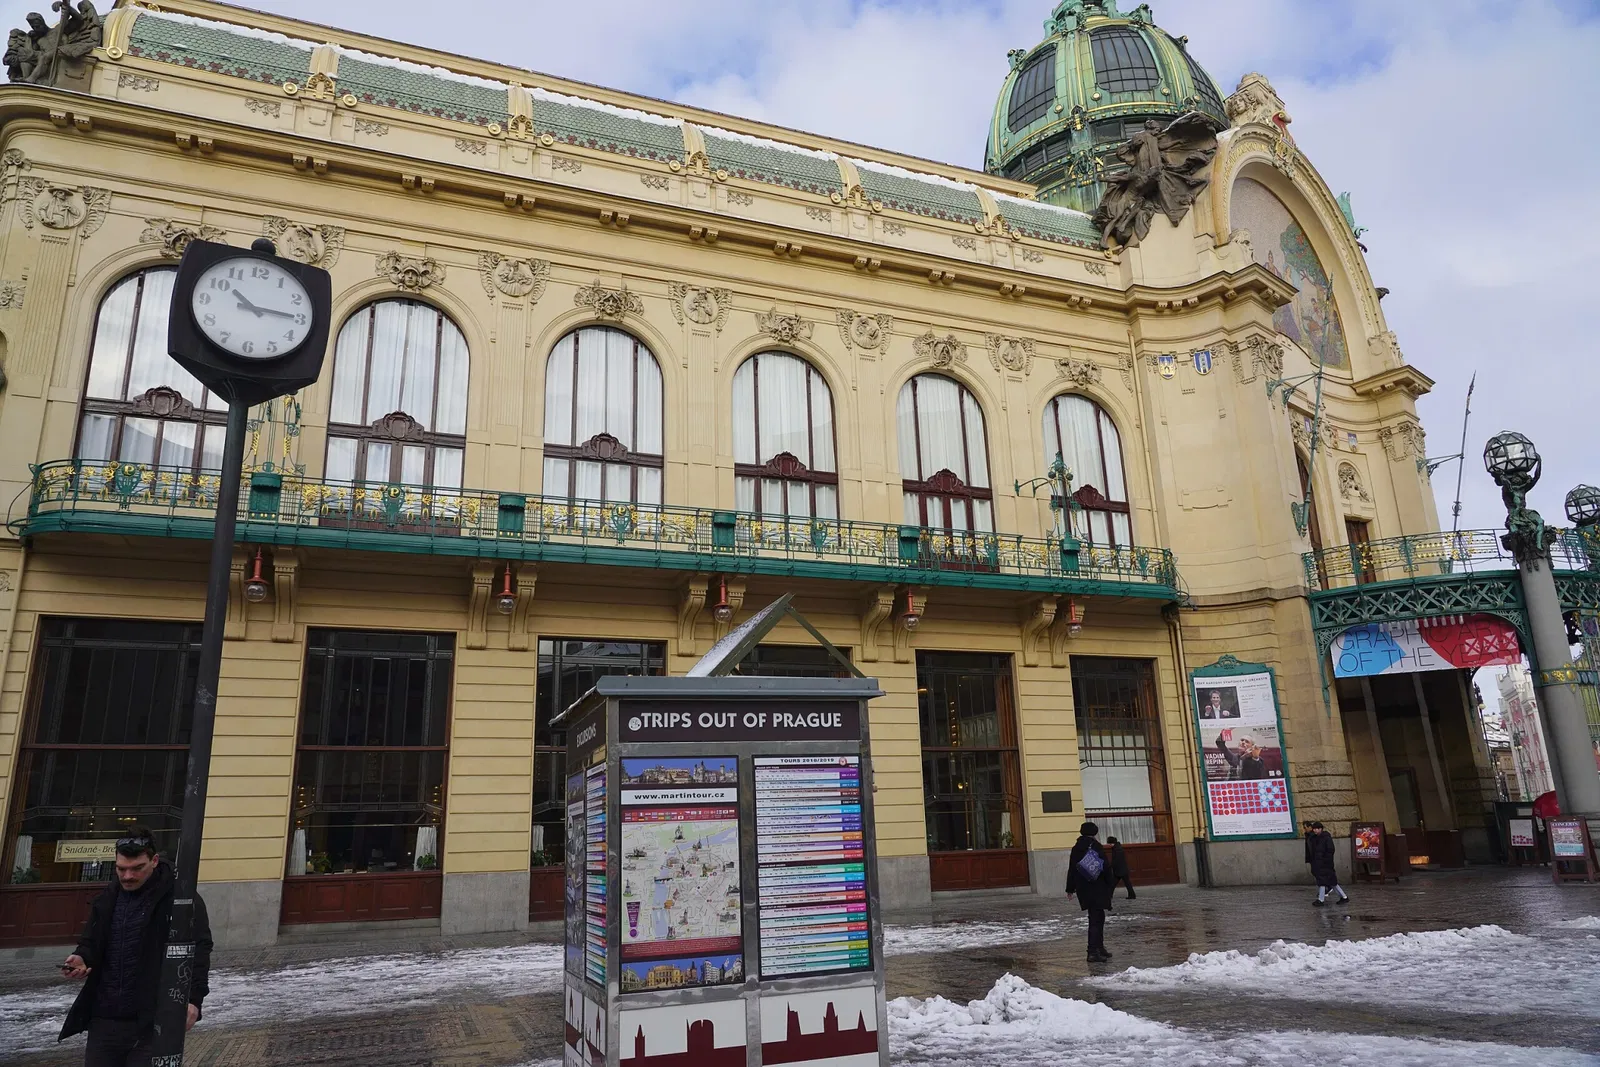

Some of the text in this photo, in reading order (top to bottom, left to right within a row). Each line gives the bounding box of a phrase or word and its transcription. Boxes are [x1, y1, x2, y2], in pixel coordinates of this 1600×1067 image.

[228, 266, 244, 281] 11
[250, 266, 270, 280] 12
[209, 277, 231, 291] 10
[276, 277, 285, 289] 1
[199, 292, 211, 305] 9
[290, 293, 303, 305] 2
[203, 313, 216, 327] 8
[295, 313, 307, 326] 3
[219, 331, 232, 344] 7
[283, 329, 295, 342] 4
[242, 340, 254, 354] 6
[267, 340, 278, 353] 5
[1335, 620, 1449, 651] GRAPHIC
[1339, 651, 1372, 672] OF
[1381, 646, 1434, 668] THE
[641, 712, 842, 728] TRIPS OUT OF PRAGUE
[634, 792, 725, 800] www.martintour.cz
